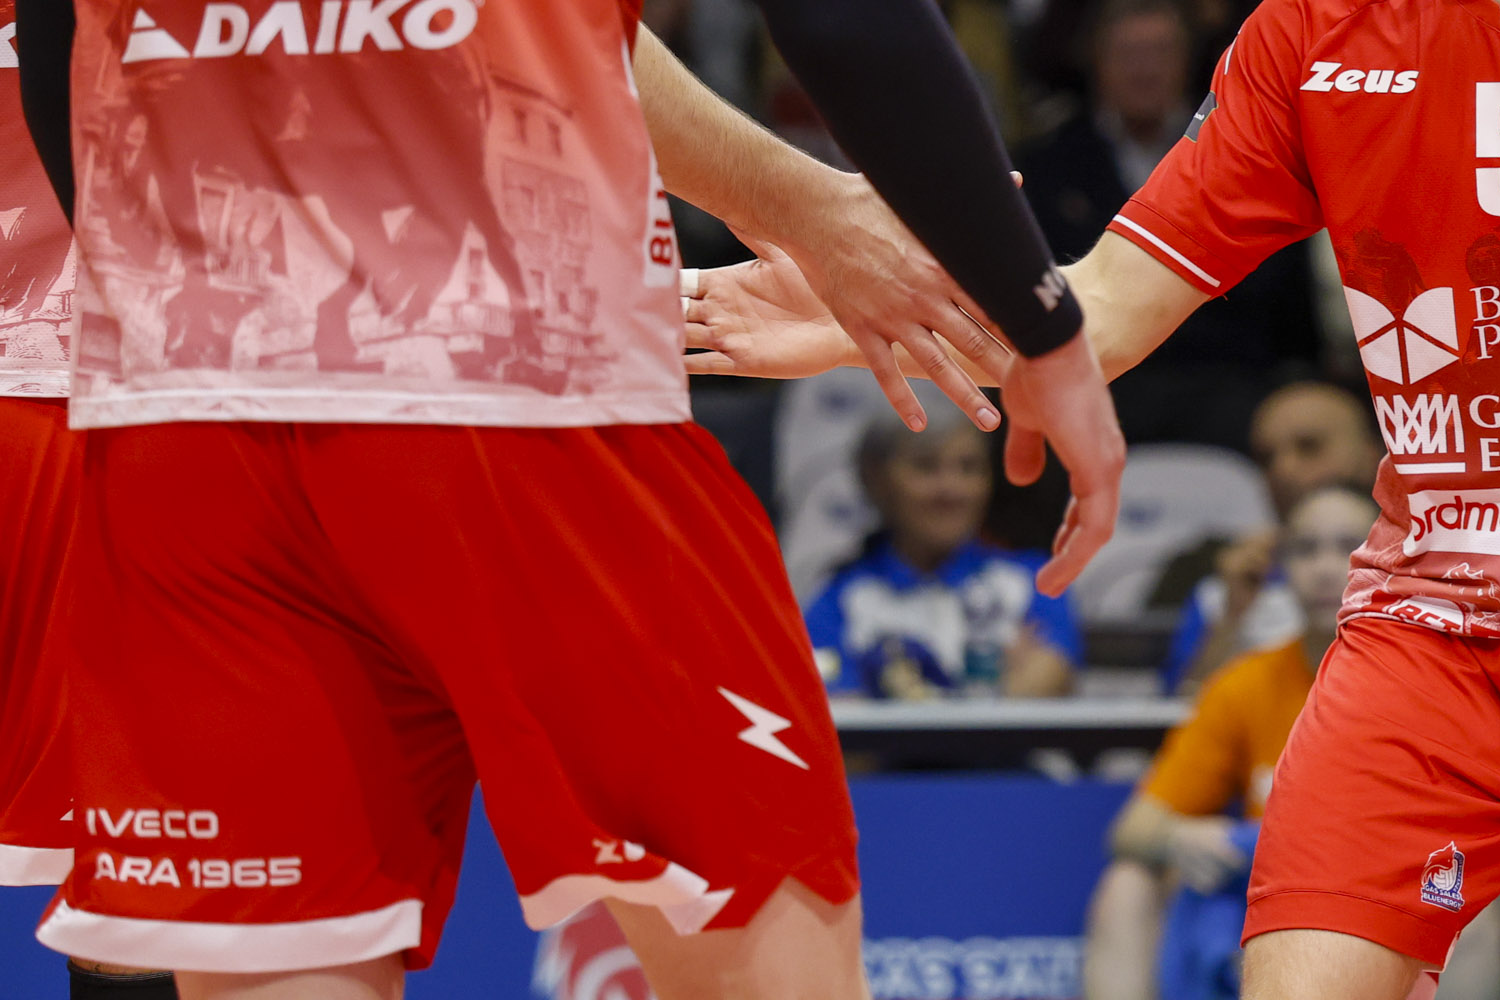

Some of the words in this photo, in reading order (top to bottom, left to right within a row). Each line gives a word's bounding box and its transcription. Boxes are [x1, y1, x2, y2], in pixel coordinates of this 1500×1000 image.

[1300, 61, 1419, 94] Zeus
[86, 808, 219, 840] IVECO
[95, 852, 181, 888] ARA
[187, 857, 302, 888] 1965
